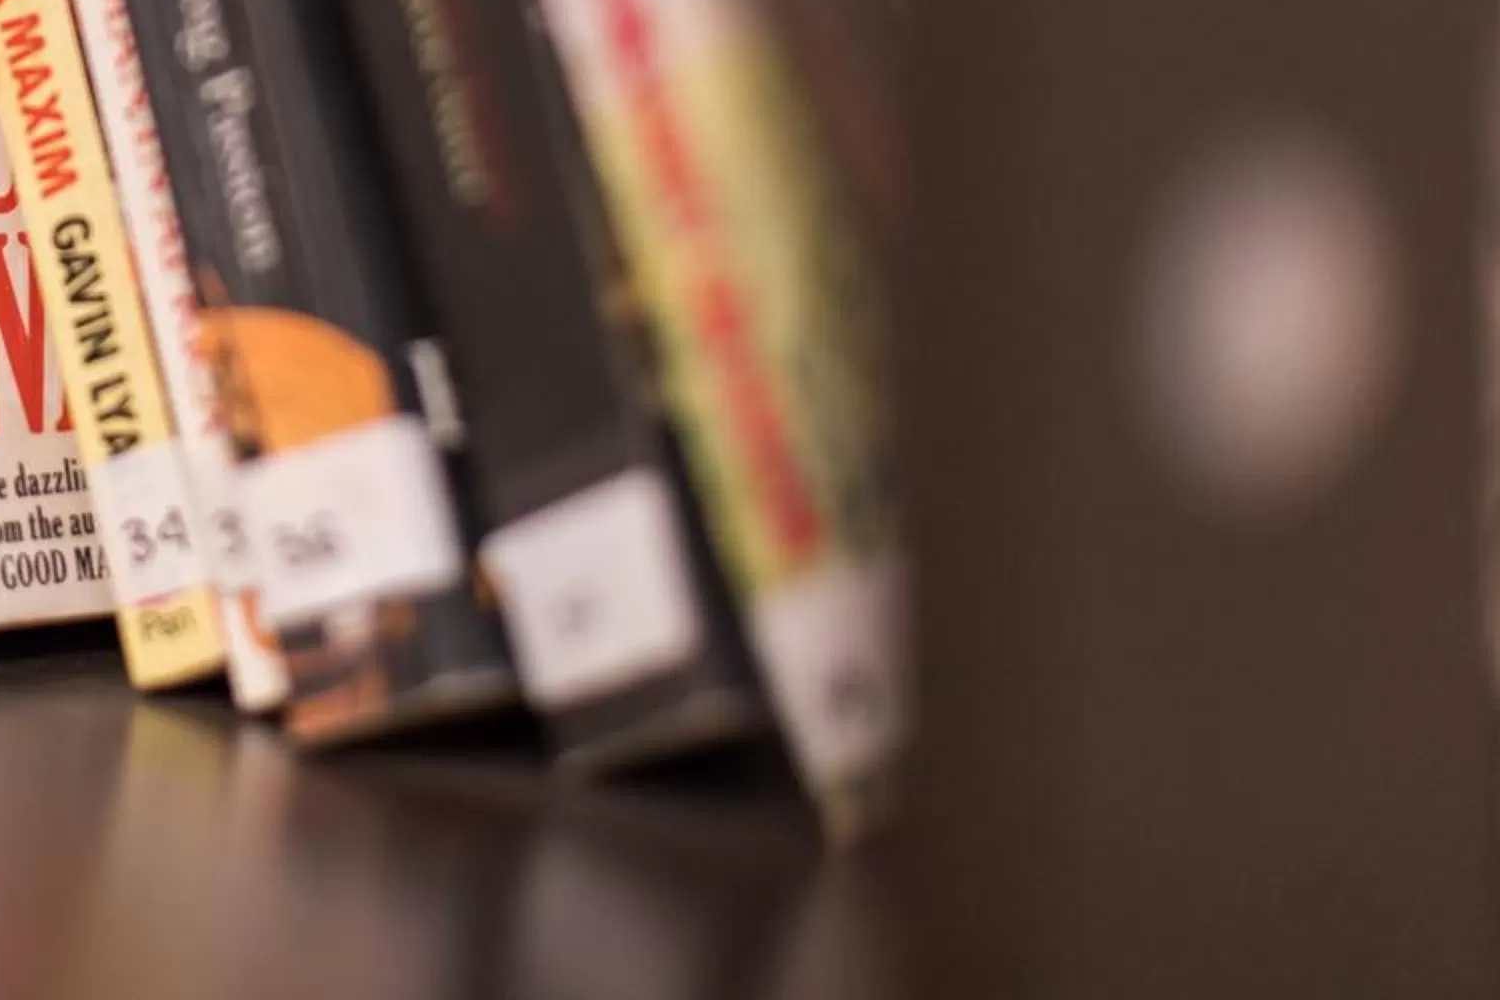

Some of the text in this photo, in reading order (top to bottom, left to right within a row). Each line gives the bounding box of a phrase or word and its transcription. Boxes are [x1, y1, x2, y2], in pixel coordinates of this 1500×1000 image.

[0, 13, 81, 201] MAXIM
[52, 215, 124, 366] GAVIN
[29, 504, 65, 542] the
[120, 504, 191, 568] 34
[0, 548, 67, 591] GOOD
